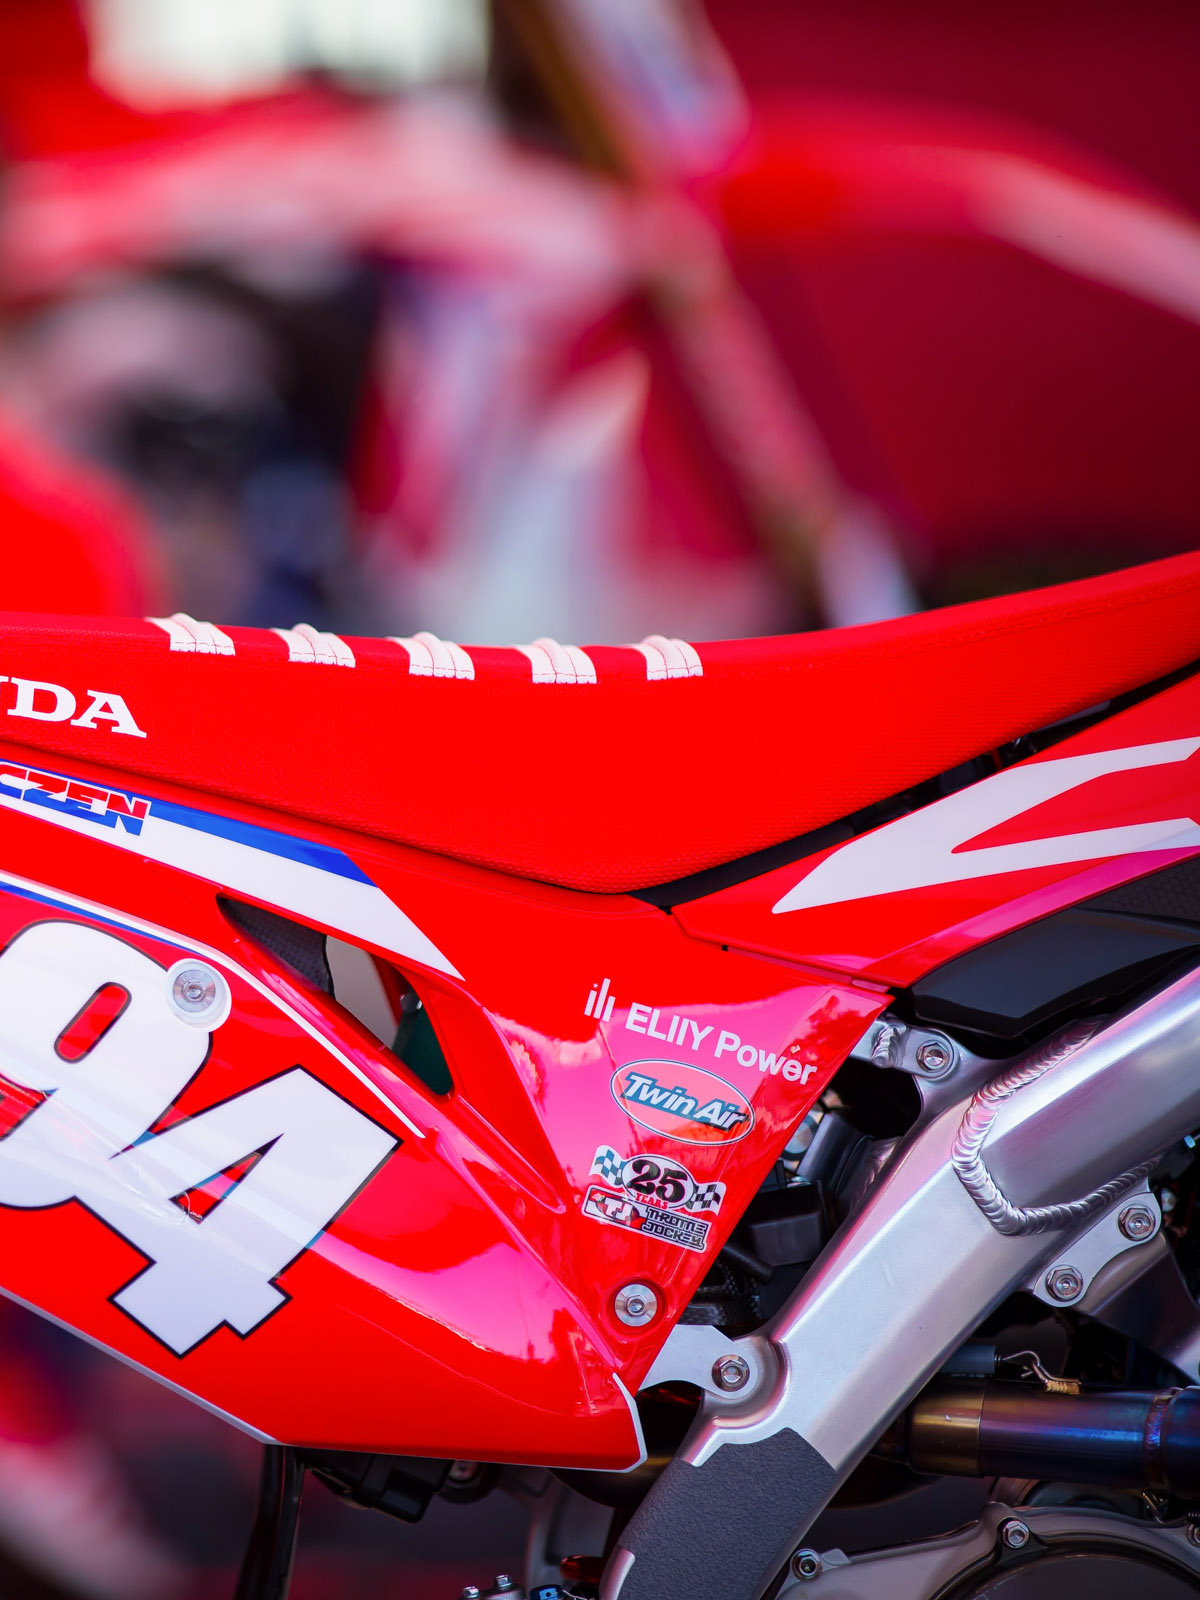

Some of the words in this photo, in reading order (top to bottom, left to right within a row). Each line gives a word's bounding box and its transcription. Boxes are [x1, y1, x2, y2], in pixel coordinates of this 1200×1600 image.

[714, 1030, 818, 1085] Power
[623, 1073, 697, 1117] Twin
[695, 1099, 749, 1132] Air
[626, 1159, 688, 1203] 25
[634, 1192, 669, 1210] YEARS
[642, 1222, 703, 1249] JOCKEY
